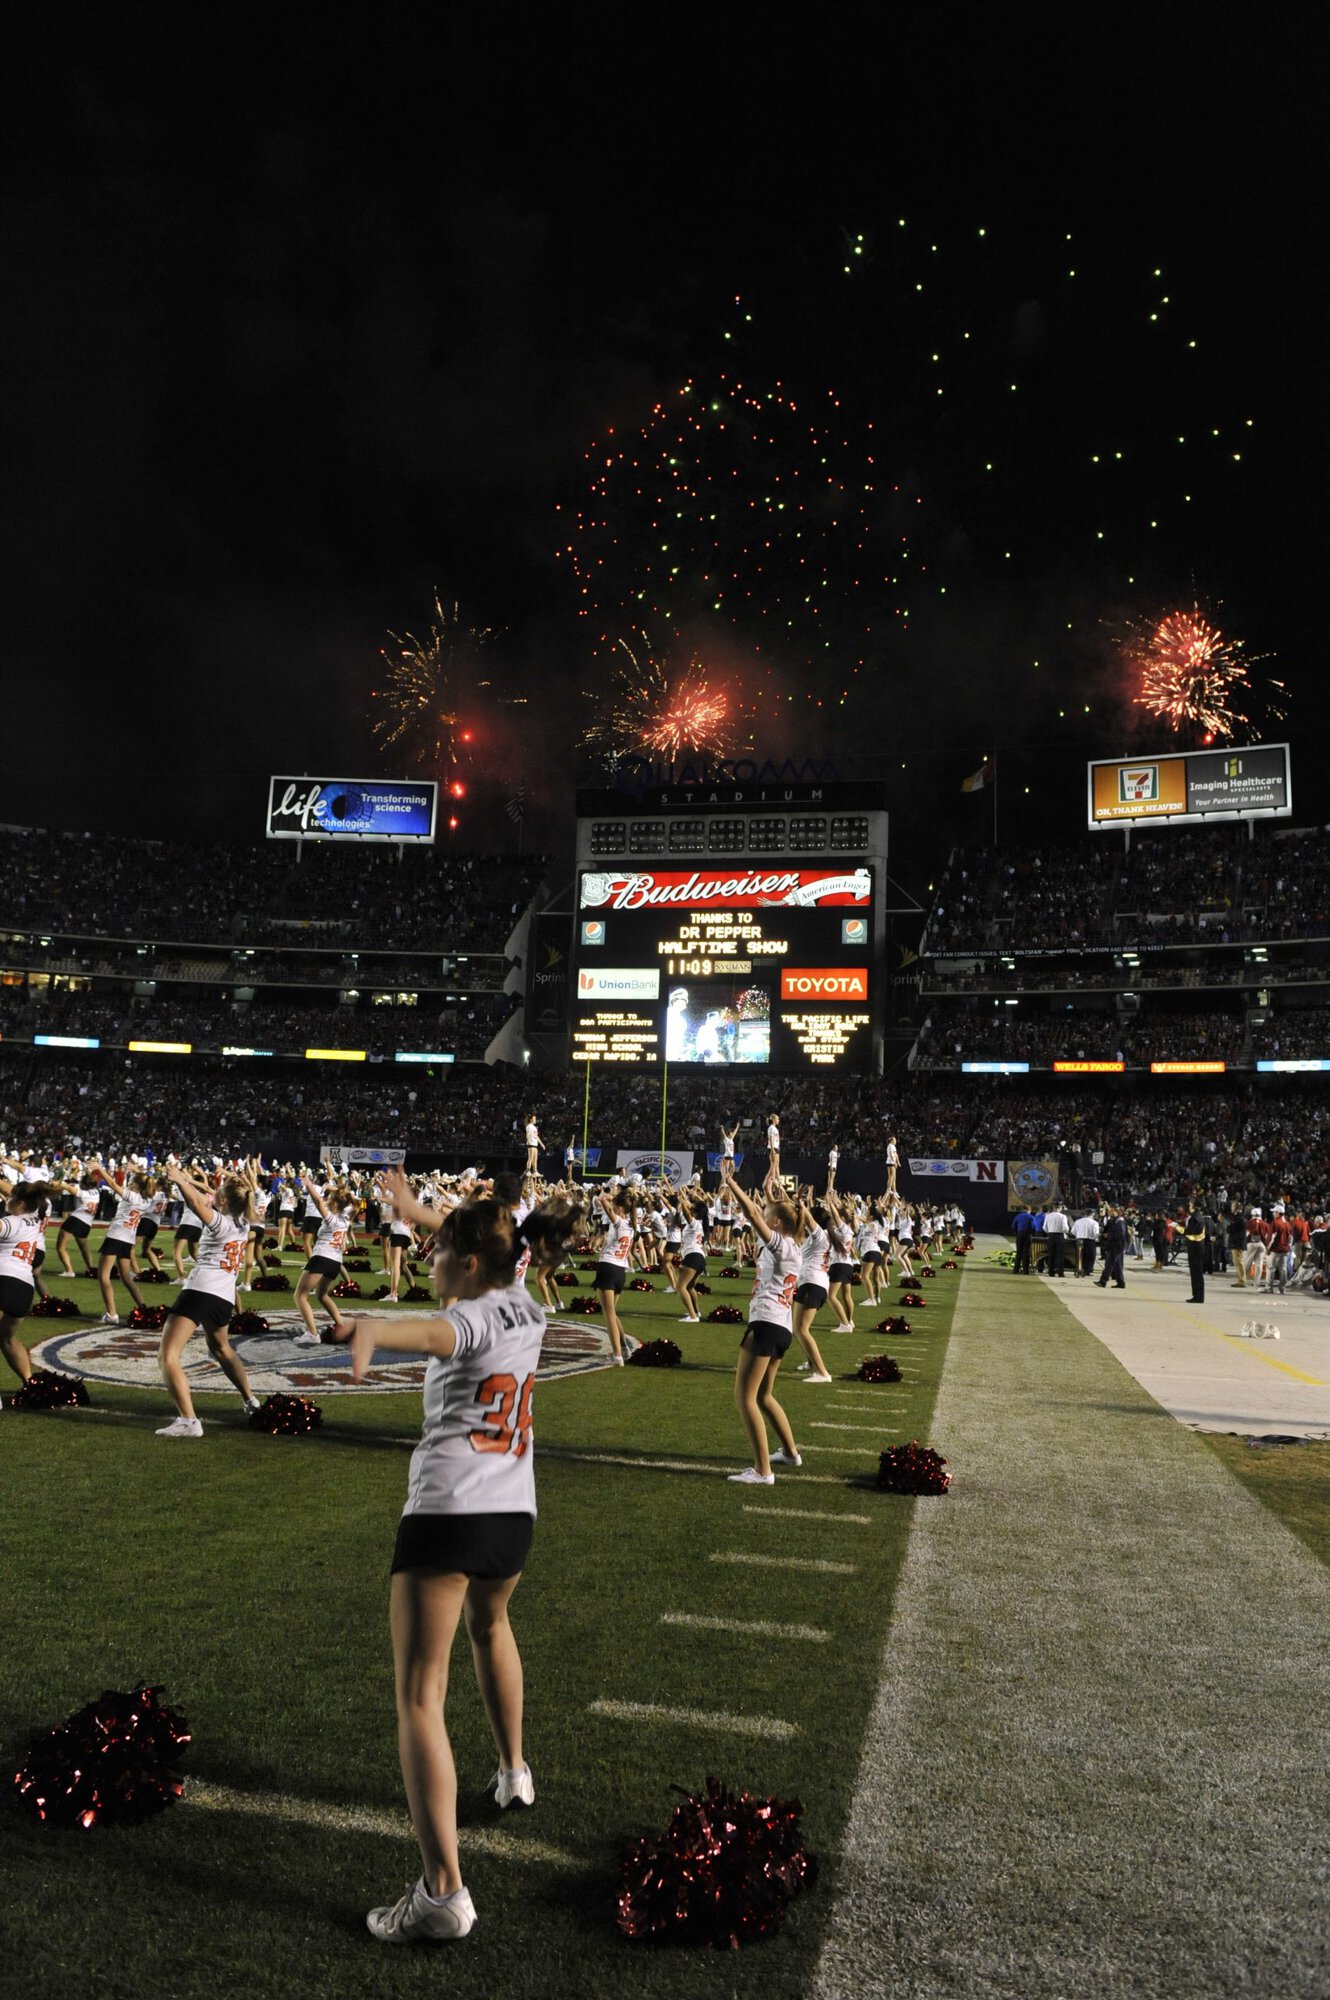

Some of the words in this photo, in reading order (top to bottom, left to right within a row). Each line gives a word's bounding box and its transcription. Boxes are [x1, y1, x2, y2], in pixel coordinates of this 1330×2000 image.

[615, 755, 840, 801] QUALCOMM
[1189, 780, 1228, 792] Imaging
[1229, 776, 1283, 789] Healthcare
[661, 789, 823, 802] STADIUM
[1126, 785, 1151, 793] ELEVEN
[271, 783, 328, 829] life
[360, 793, 428, 806] Transforming
[1195, 799, 1211, 807] Your
[1213, 796, 1239, 805] Partner
[1240, 795, 1249, 803] in
[1250, 793, 1275, 802] Health
[375, 804, 412, 813] science
[1096, 808, 1112, 817] OH,
[1113, 805, 1144, 815] THANK
[310, 817, 371, 829] technologies
[606, 870, 800, 910] Budweiser
[801, 882, 843, 901] American
[843, 881, 869, 893] Lager
[690, 912, 734, 924] THANKS
[737, 912, 753, 924] TO
[680, 926, 701, 939] DR
[706, 926, 762, 939] PEPPER
[658, 941, 738, 954] HALFTIME
[746, 941, 789, 954] SHOW
[785, 977, 864, 993] TOYOTA
[802, 1015, 843, 1024] PACIFIC
[845, 1015, 870, 1024] LIFE
[1056, 1063, 1088, 1071] WELLS
[1089, 1062, 1123, 1071] FARGO
[634, 1156, 660, 1167] PACIFIC
[977, 1161, 997, 1181] N
